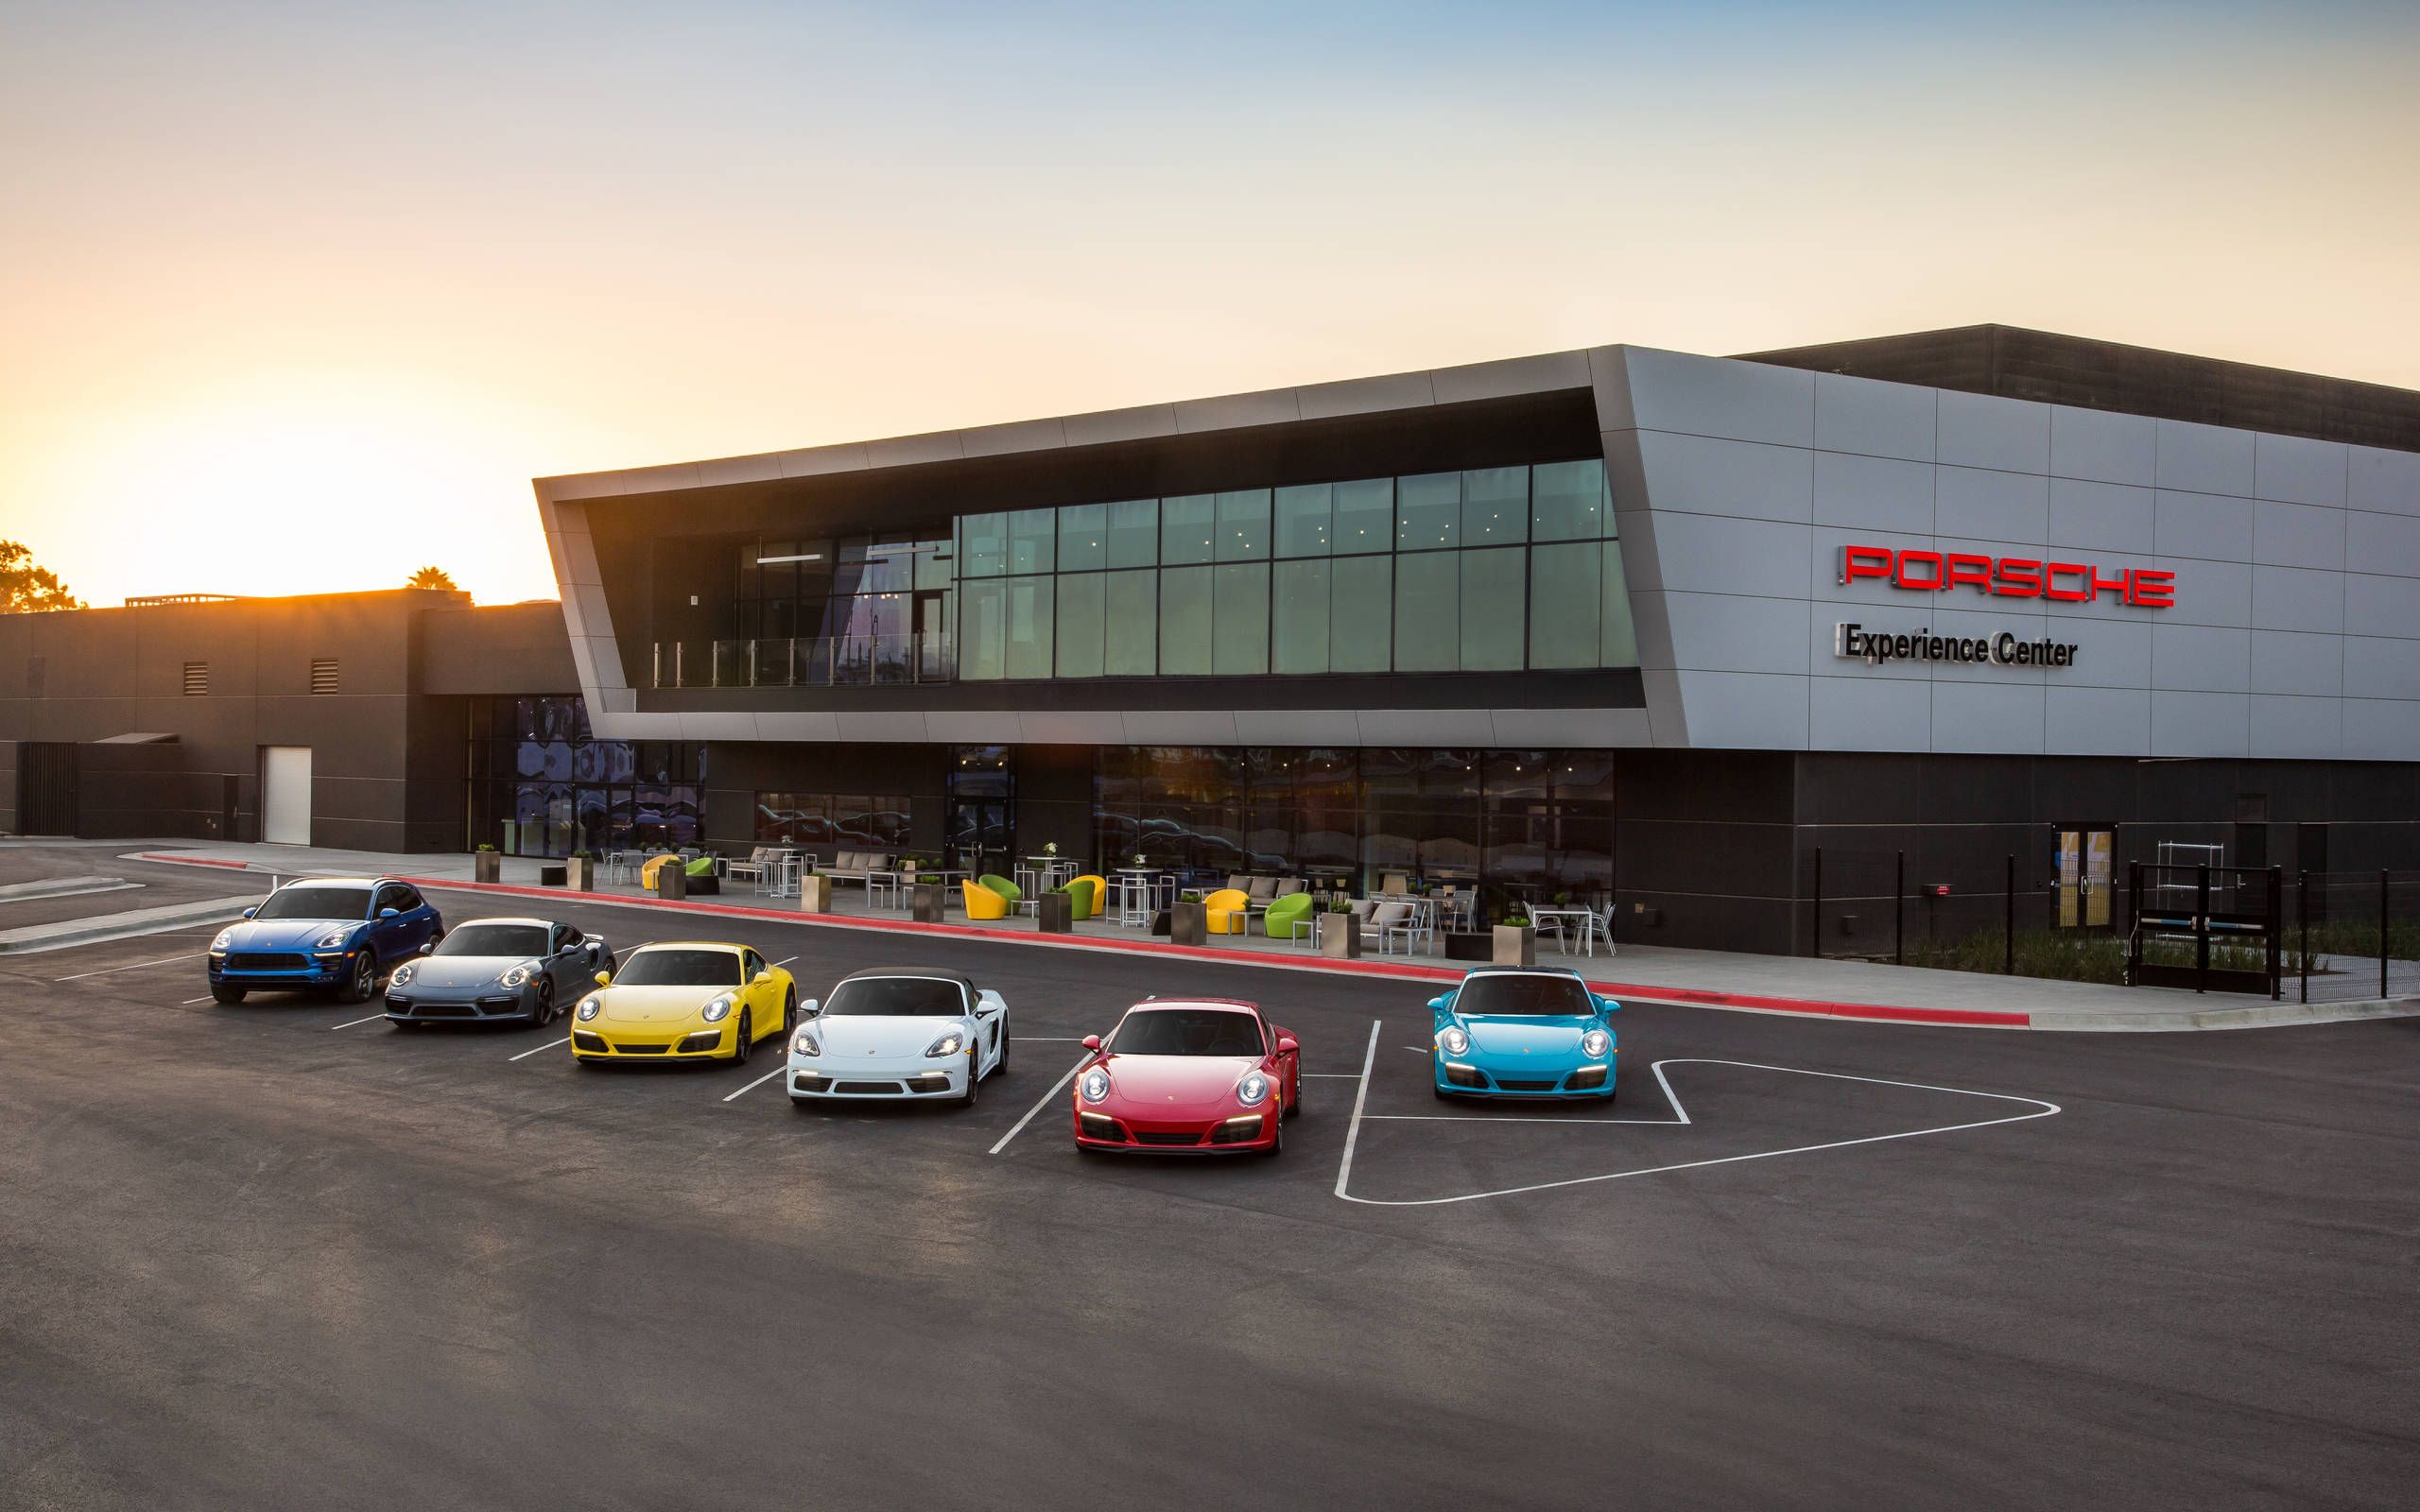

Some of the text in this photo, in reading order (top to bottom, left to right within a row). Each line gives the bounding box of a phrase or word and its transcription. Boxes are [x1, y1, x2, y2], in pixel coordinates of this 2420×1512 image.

[1844, 545, 2175, 608] PORSCHE
[1845, 623, 2078, 666] Experience Center
